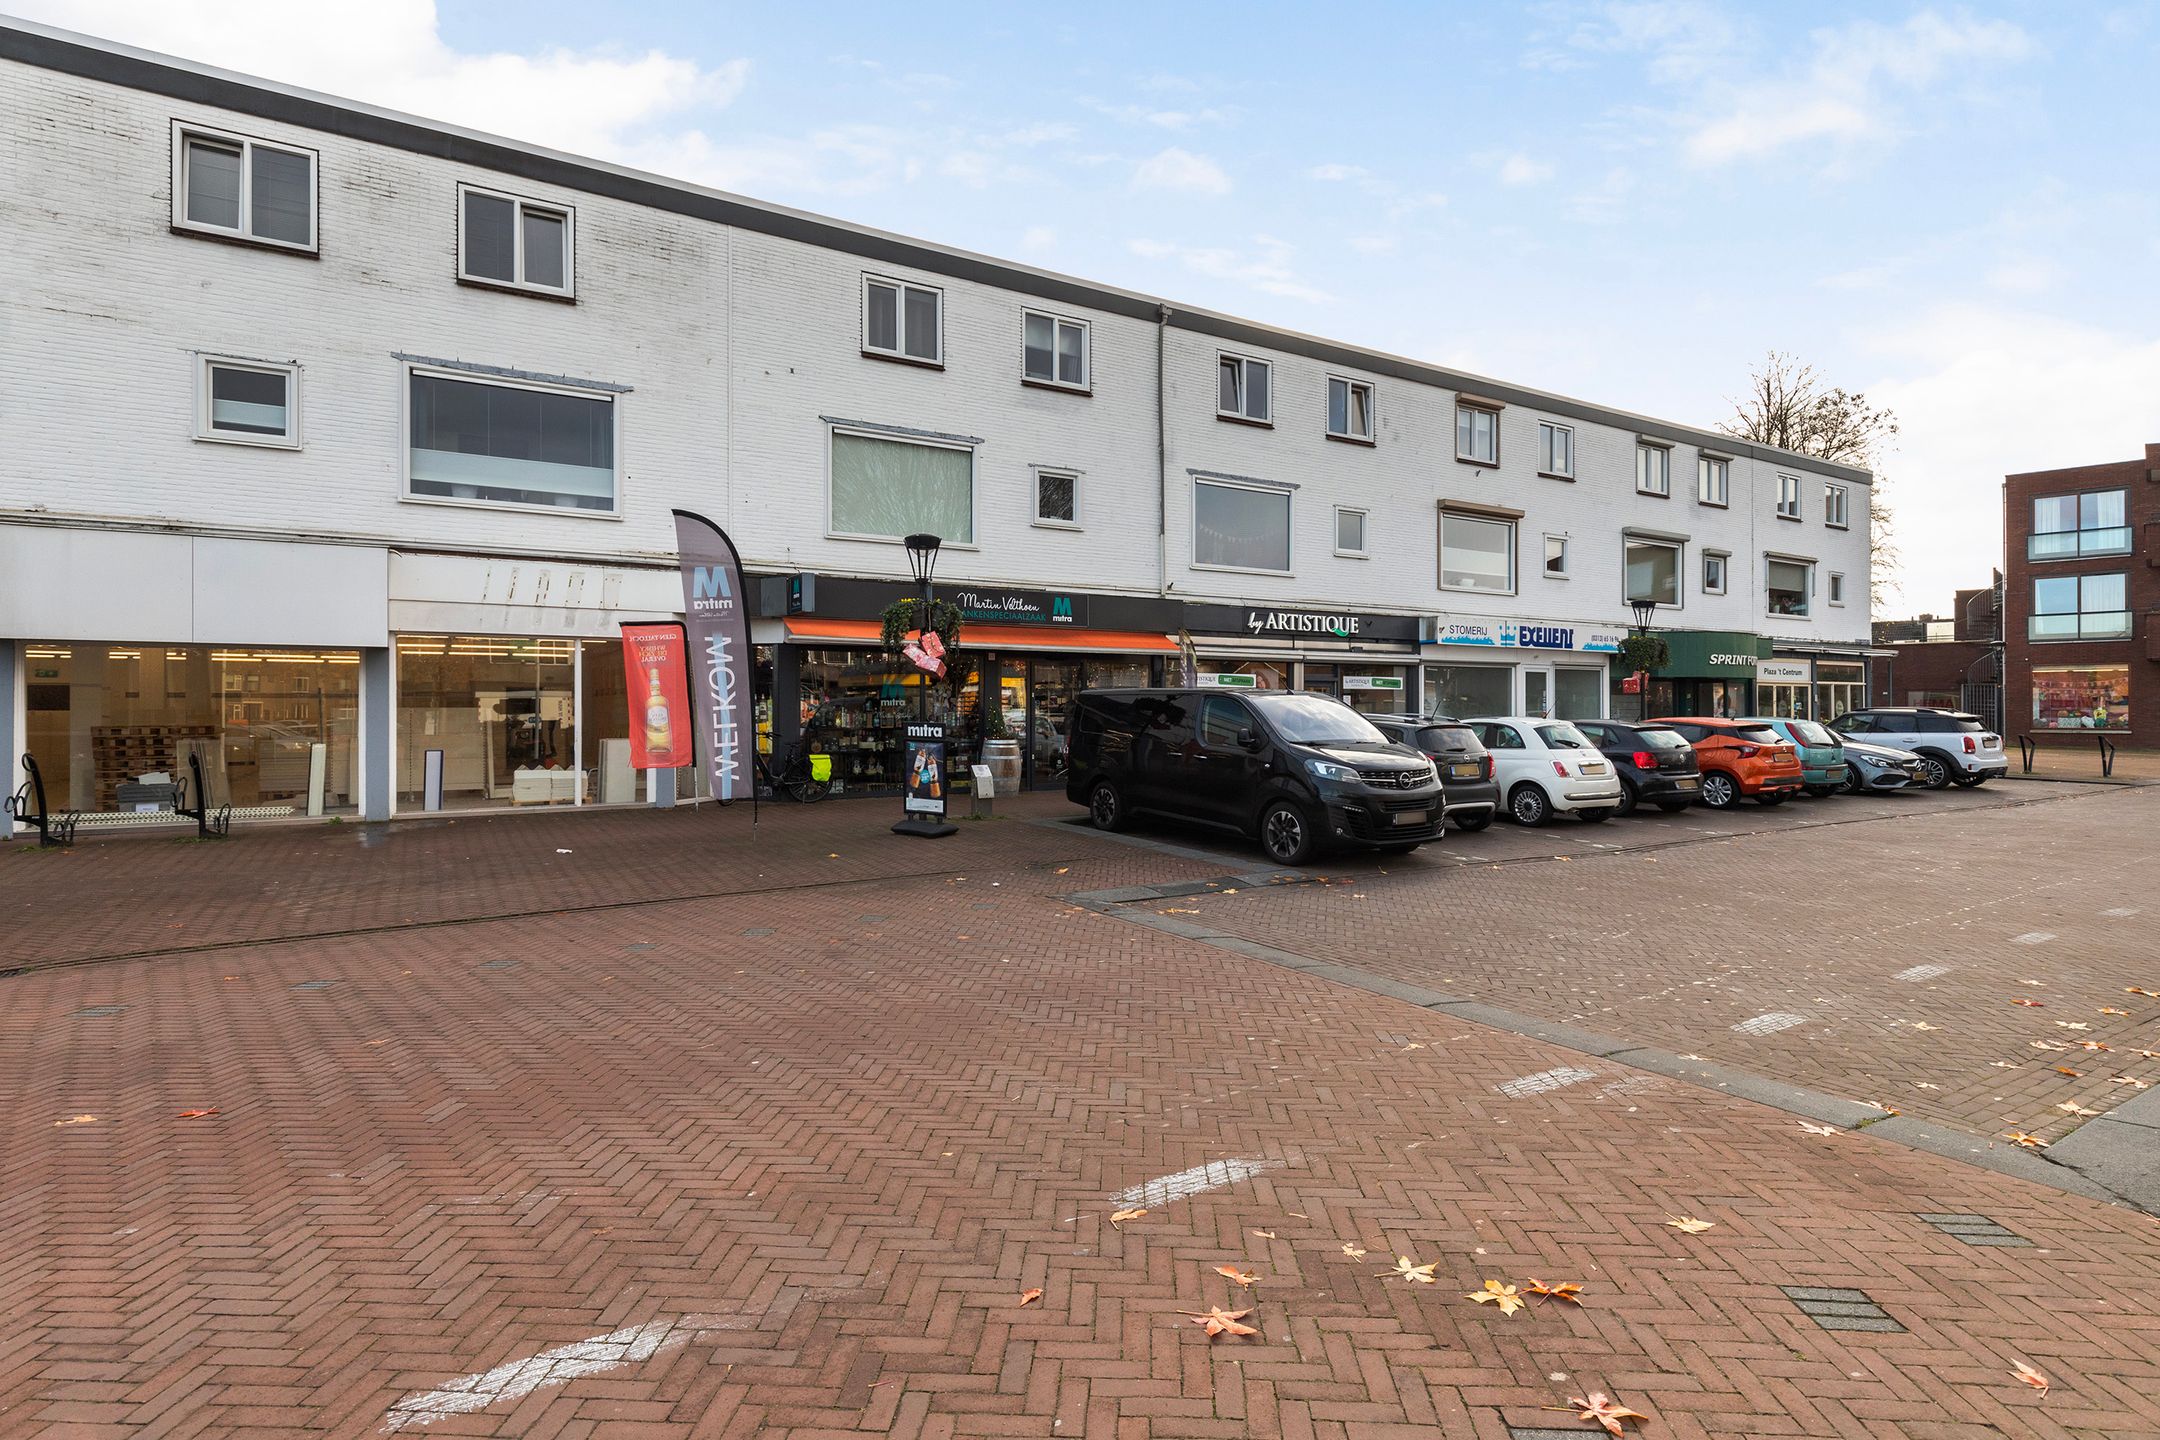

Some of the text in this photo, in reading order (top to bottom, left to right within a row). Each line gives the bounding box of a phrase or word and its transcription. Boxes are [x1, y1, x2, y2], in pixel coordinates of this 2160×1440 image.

[957, 592, 1001, 610] Martin
[962, 609, 1046, 621] ANKENSPECIAALZAAK
[1247, 611, 1359, 637] by ARTISTIQUE
[1449, 624, 1488, 636] STOMERIJ
[1764, 667, 1776, 675] Plaza
[1782, 668, 1803, 676] Centrum
[881, 698, 906, 706] mitra
[907, 724, 943, 737] mitra
